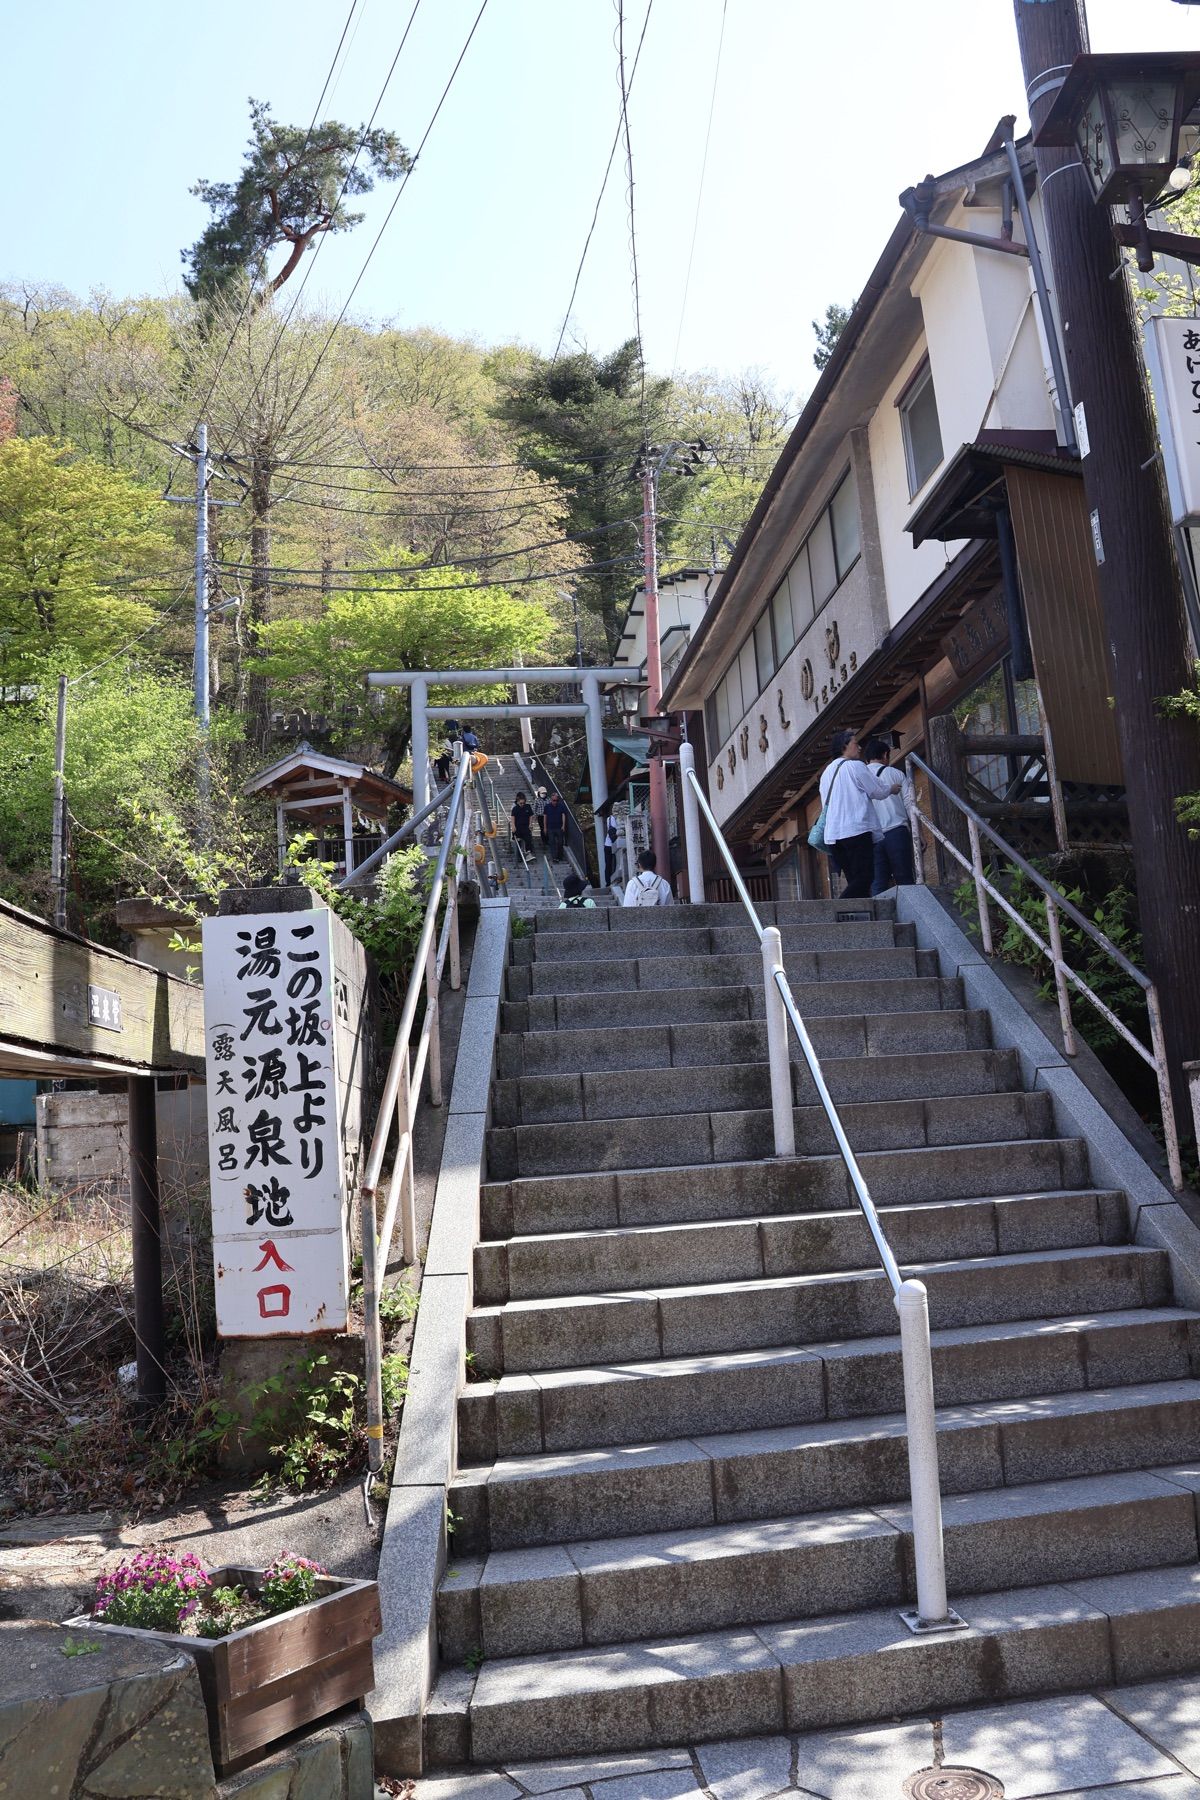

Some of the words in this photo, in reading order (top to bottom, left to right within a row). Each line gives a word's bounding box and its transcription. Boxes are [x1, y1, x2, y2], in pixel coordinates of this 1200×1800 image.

[235, 926, 294, 1228] 湯元源泉地
[286, 925, 327, 1180] この坂上より
[251, 1239, 296, 1319] 入口
